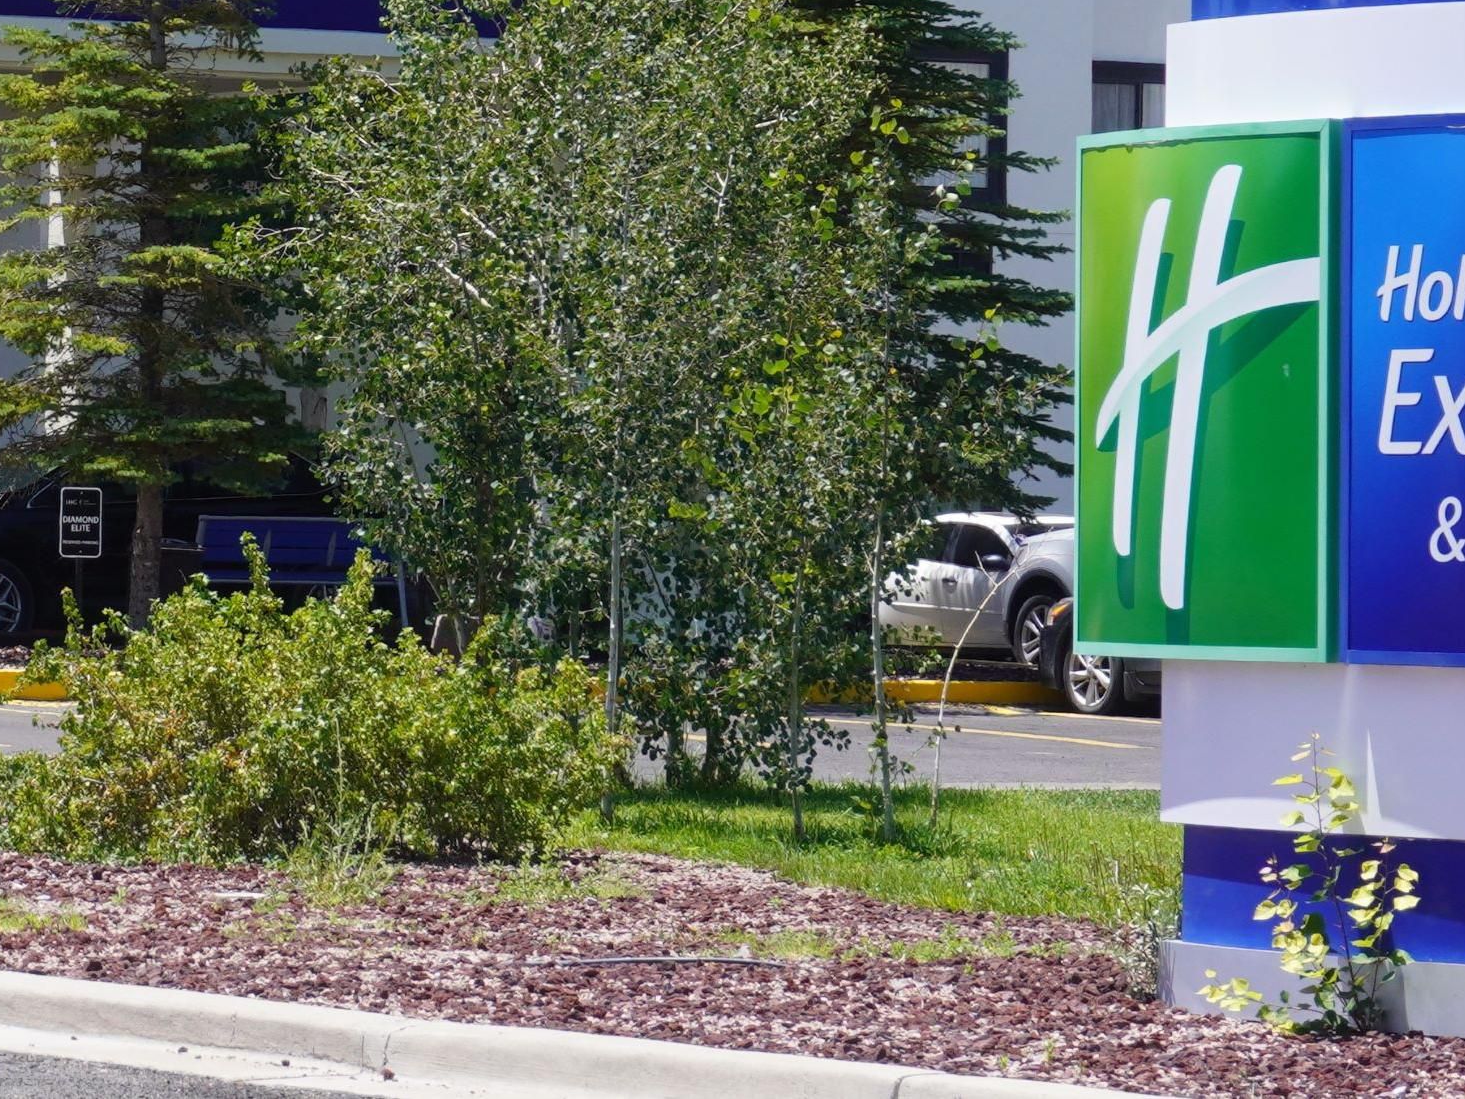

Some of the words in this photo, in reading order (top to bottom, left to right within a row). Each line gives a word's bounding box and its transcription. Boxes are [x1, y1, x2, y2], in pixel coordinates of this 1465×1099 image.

[1376, 243, 1465, 322] Hol
[1377, 348, 1465, 455] Ex
[62, 515, 100, 524] DIAMOND
[70, 523, 91, 532] ELITE
[1429, 496, 1465, 563] &
